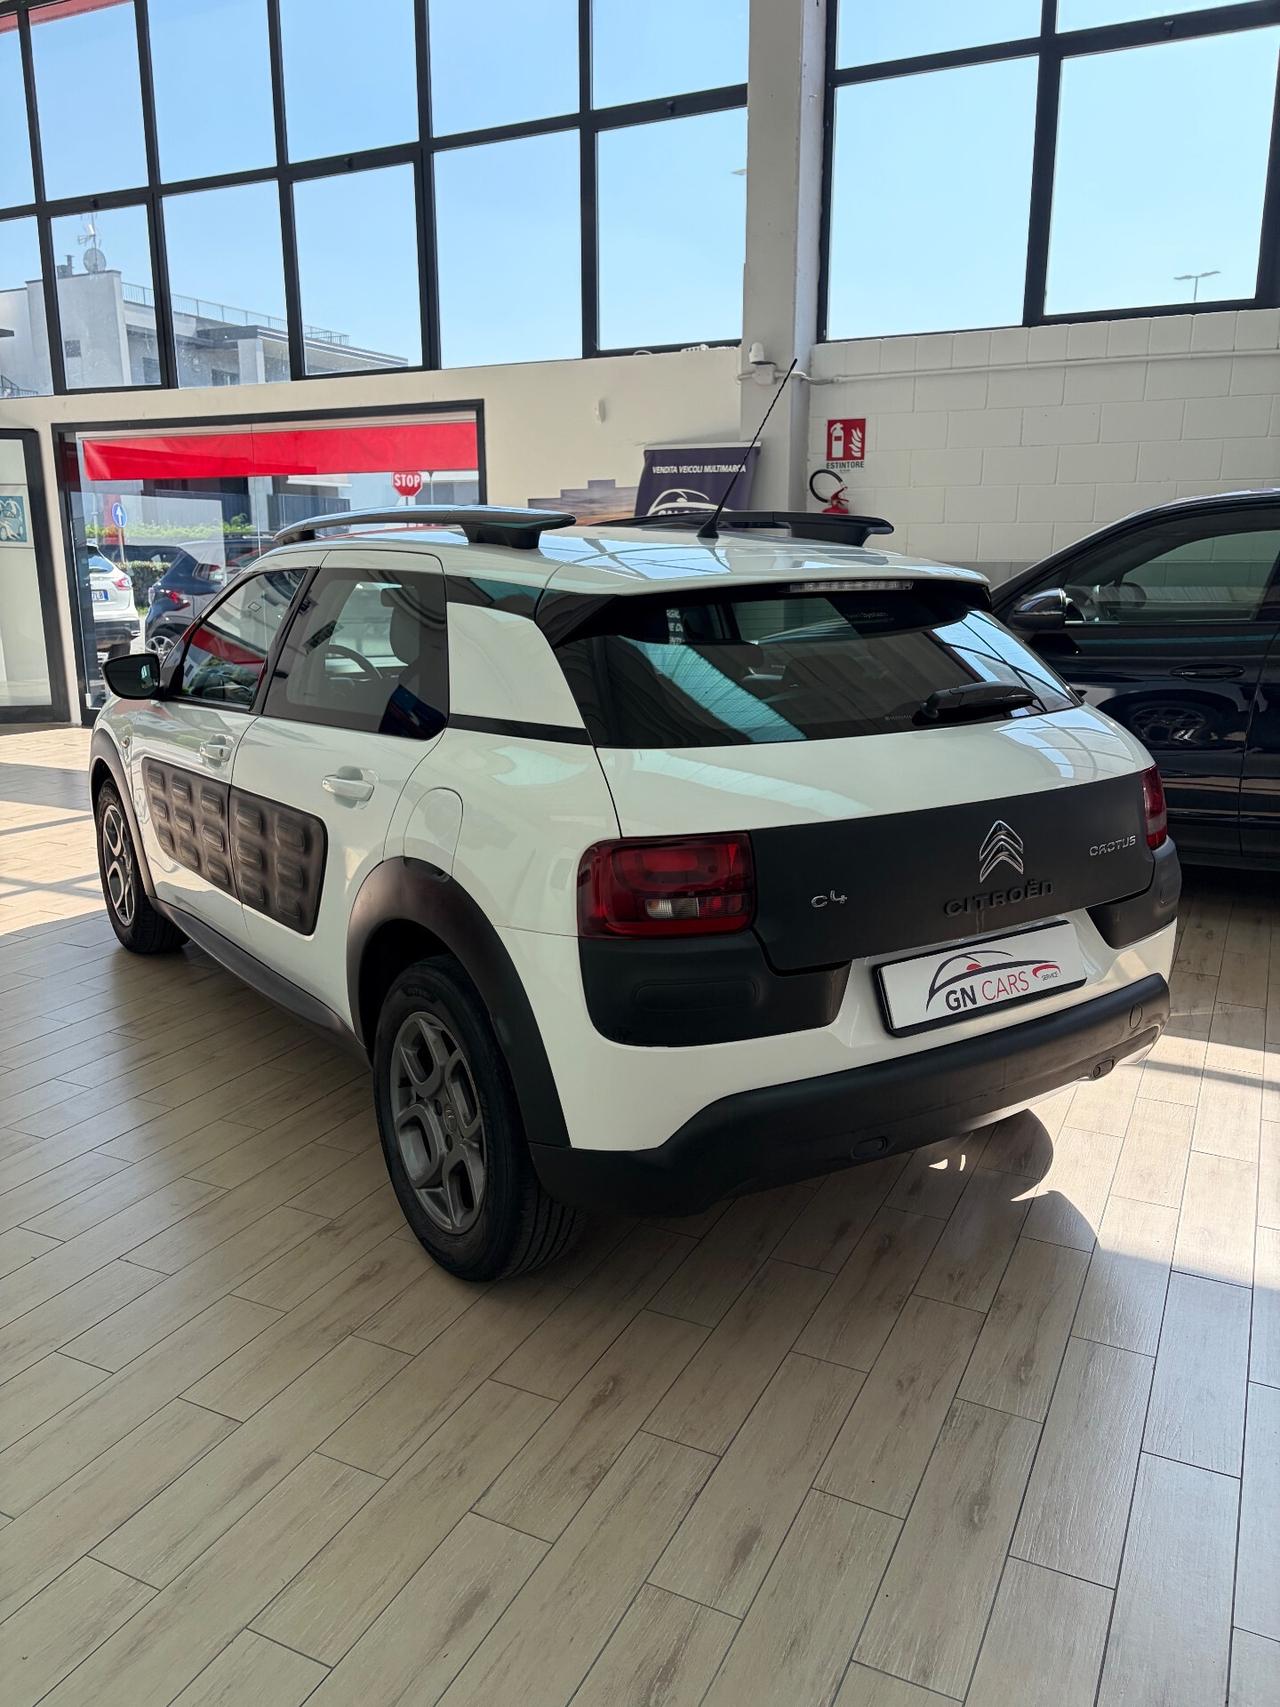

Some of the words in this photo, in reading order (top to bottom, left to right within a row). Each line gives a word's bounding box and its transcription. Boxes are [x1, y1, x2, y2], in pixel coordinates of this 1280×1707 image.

[652, 465, 678, 474] VENDITA
[679, 465, 703, 474] VEICOLI
[826, 461, 865, 470] ESTINTORE
[394, 473, 420, 487] STOP
[1089, 835, 1136, 857] CACTUS
[811, 889, 848, 908] C4
[945, 984, 978, 1011] GN
[981, 970, 1030, 1002] CARS
